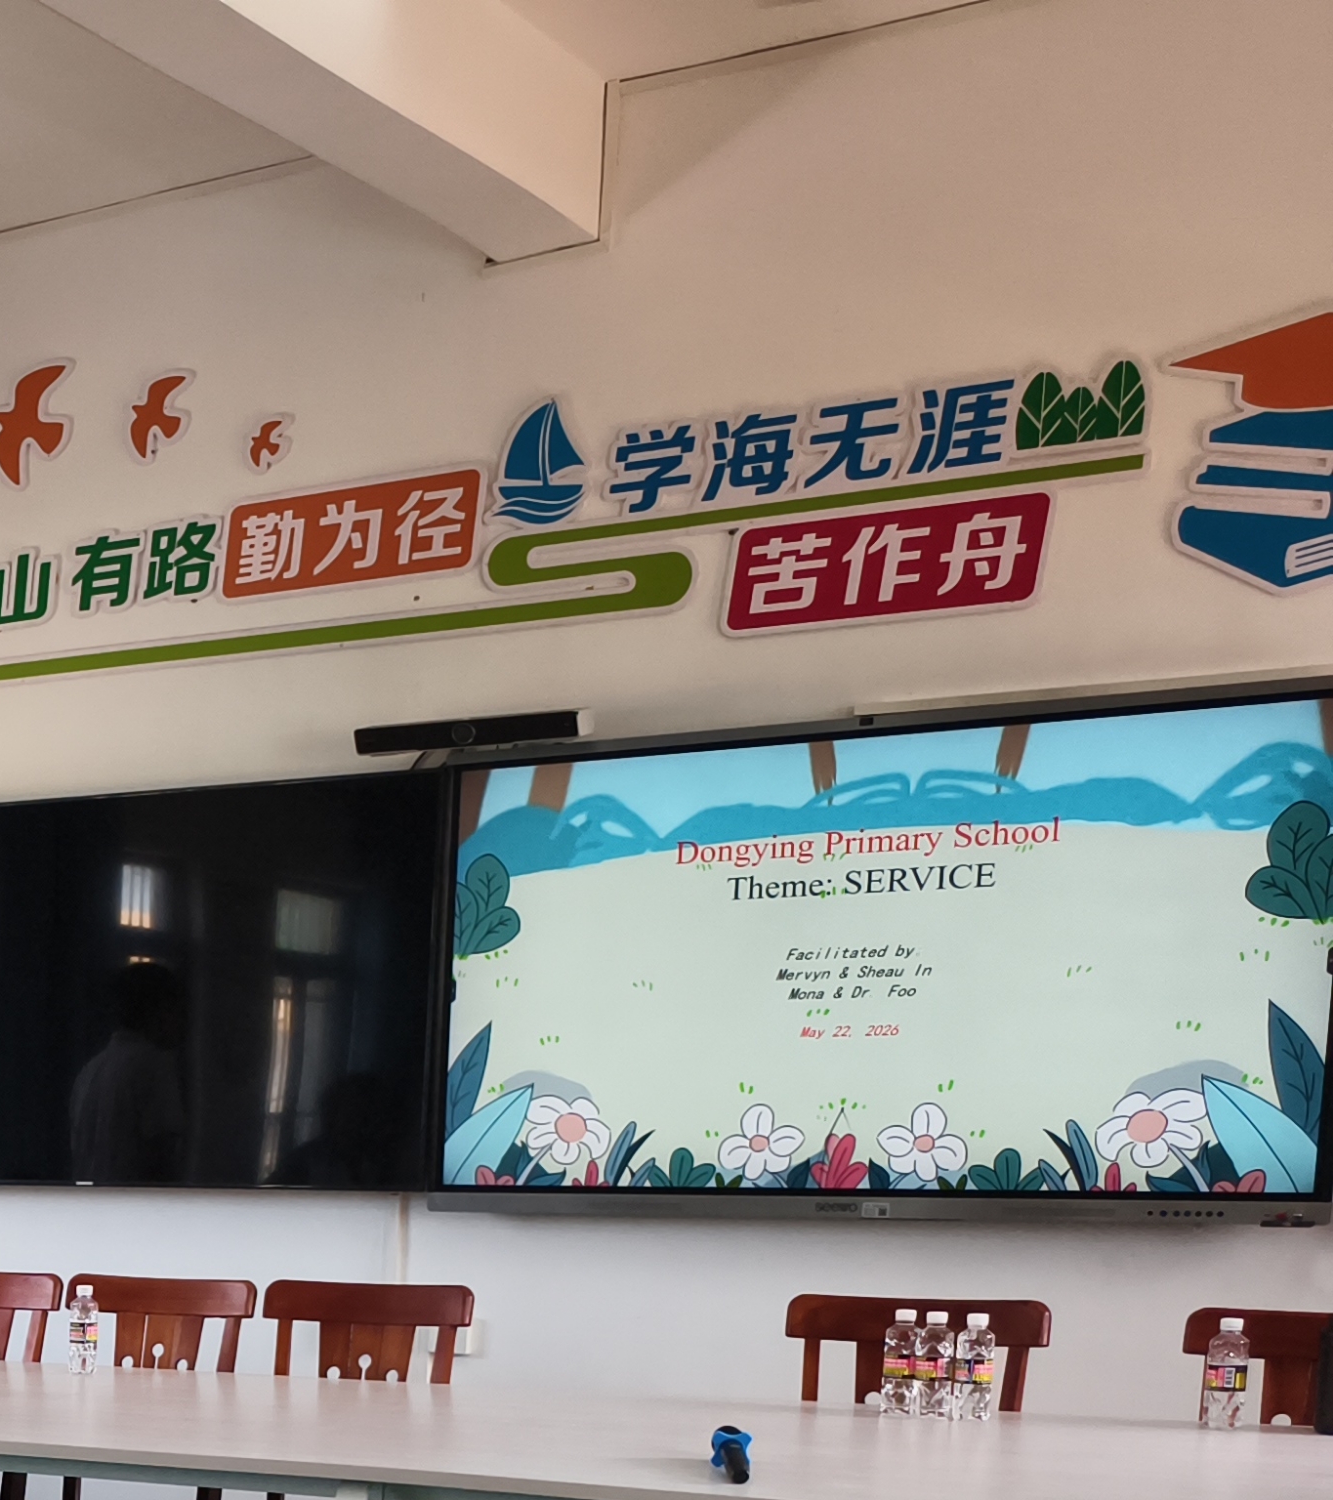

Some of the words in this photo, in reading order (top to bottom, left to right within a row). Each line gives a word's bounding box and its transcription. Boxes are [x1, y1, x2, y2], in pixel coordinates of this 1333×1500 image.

[609, 379, 1016, 514] 学海无涯
[234, 486, 466, 586] 勤为径
[747, 511, 1028, 615] 苦作舟
[675, 835, 815, 868] Dongying
[823, 828, 944, 857] Primary
[953, 817, 1061, 849] School
[727, 876, 832, 901] Theme:
[844, 862, 997, 896] SERVICE
[776, 968, 831, 982] Mervyn
[838, 966, 849, 979] &
[856, 965, 905, 978] Sheau
[914, 963, 933, 977] In
[786, 945, 889, 962] Facilitated
[788, 987, 825, 1001] Mona
[833, 986, 843, 999] &
[887, 984, 917, 998] Foo
[799, 1026, 826, 1040] May
[864, 1024, 900, 1037] 2026
